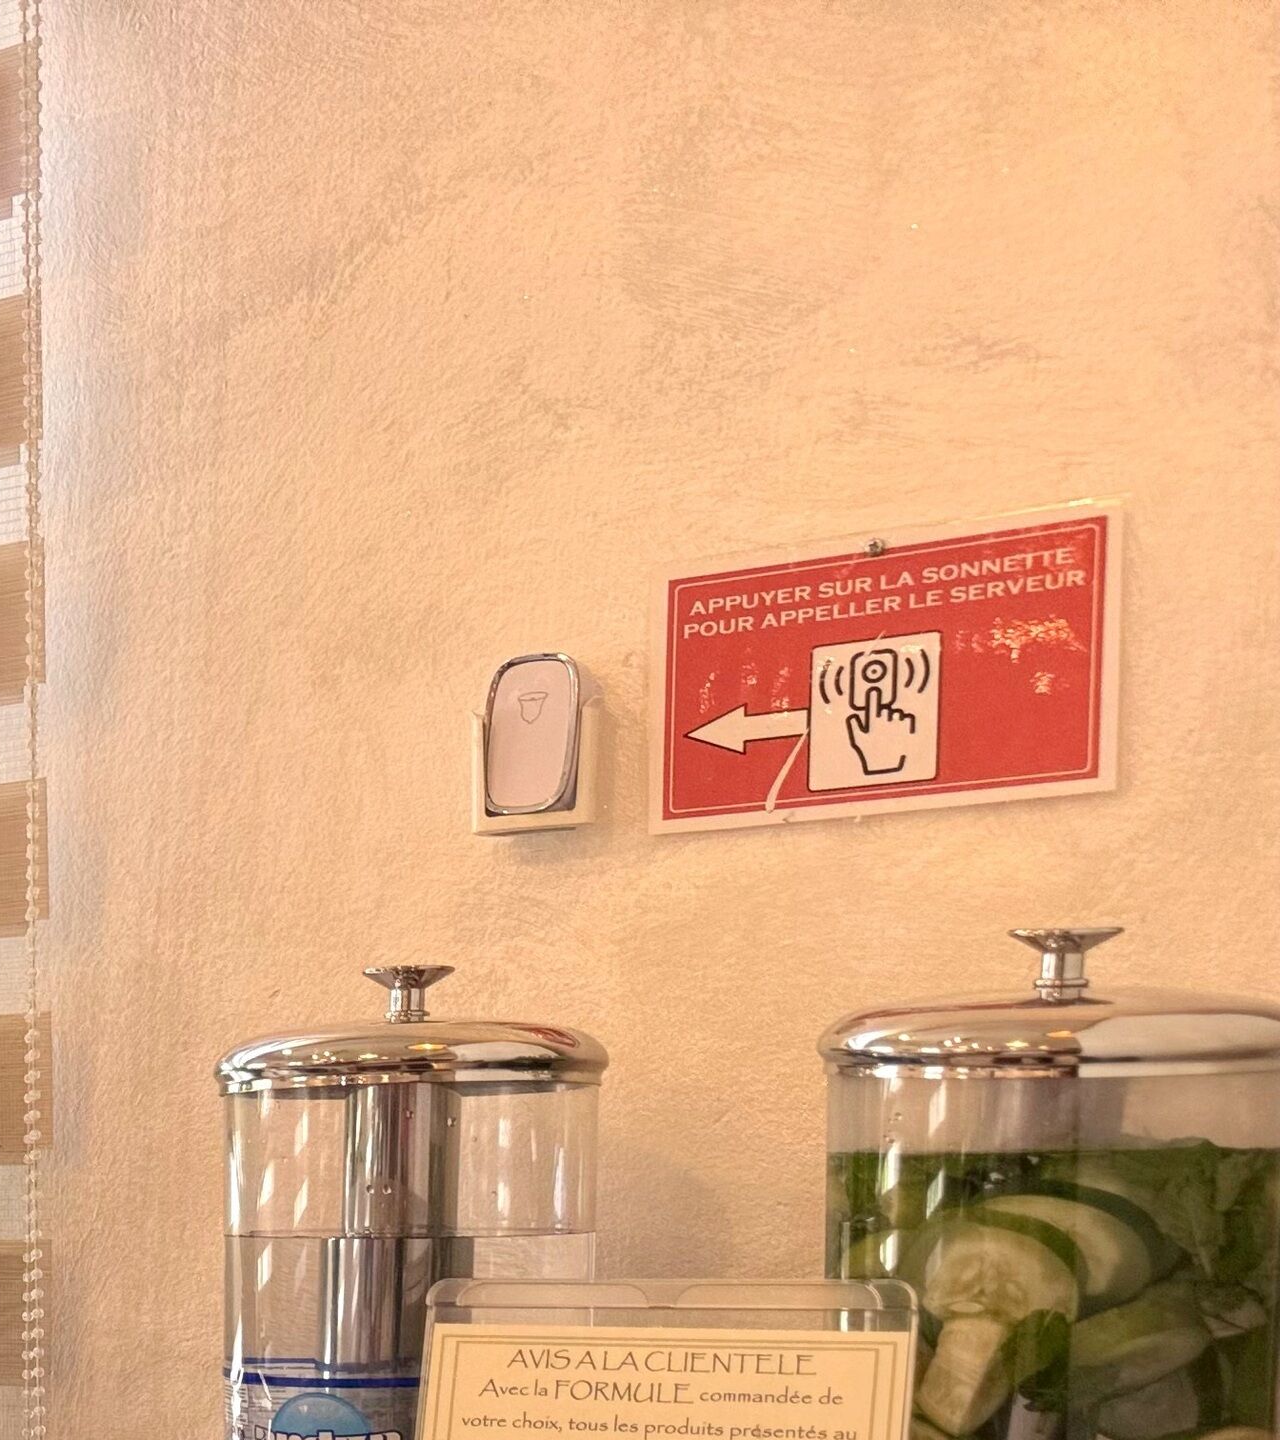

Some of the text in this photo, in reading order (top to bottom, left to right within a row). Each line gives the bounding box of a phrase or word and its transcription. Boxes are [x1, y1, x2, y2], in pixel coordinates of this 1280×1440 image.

[689, 547, 1076, 617] APPUYER SUR LA SONNETTE
[683, 569, 1086, 640] POUR APPELLER LE SERVEUR
[506, 1348, 817, 1376] AVIS A LA CLIENTELE
[478, 1378, 843, 1405] Avec la FORMULE commandée de
[462, 1415, 507, 1428] votre
[512, 1411, 563, 1433] choix,
[568, 1417, 609, 1432] tous
[614, 1414, 639, 1433] les
[643, 1417, 724, 1440] produits
[833, 1430, 858, 1440] au
